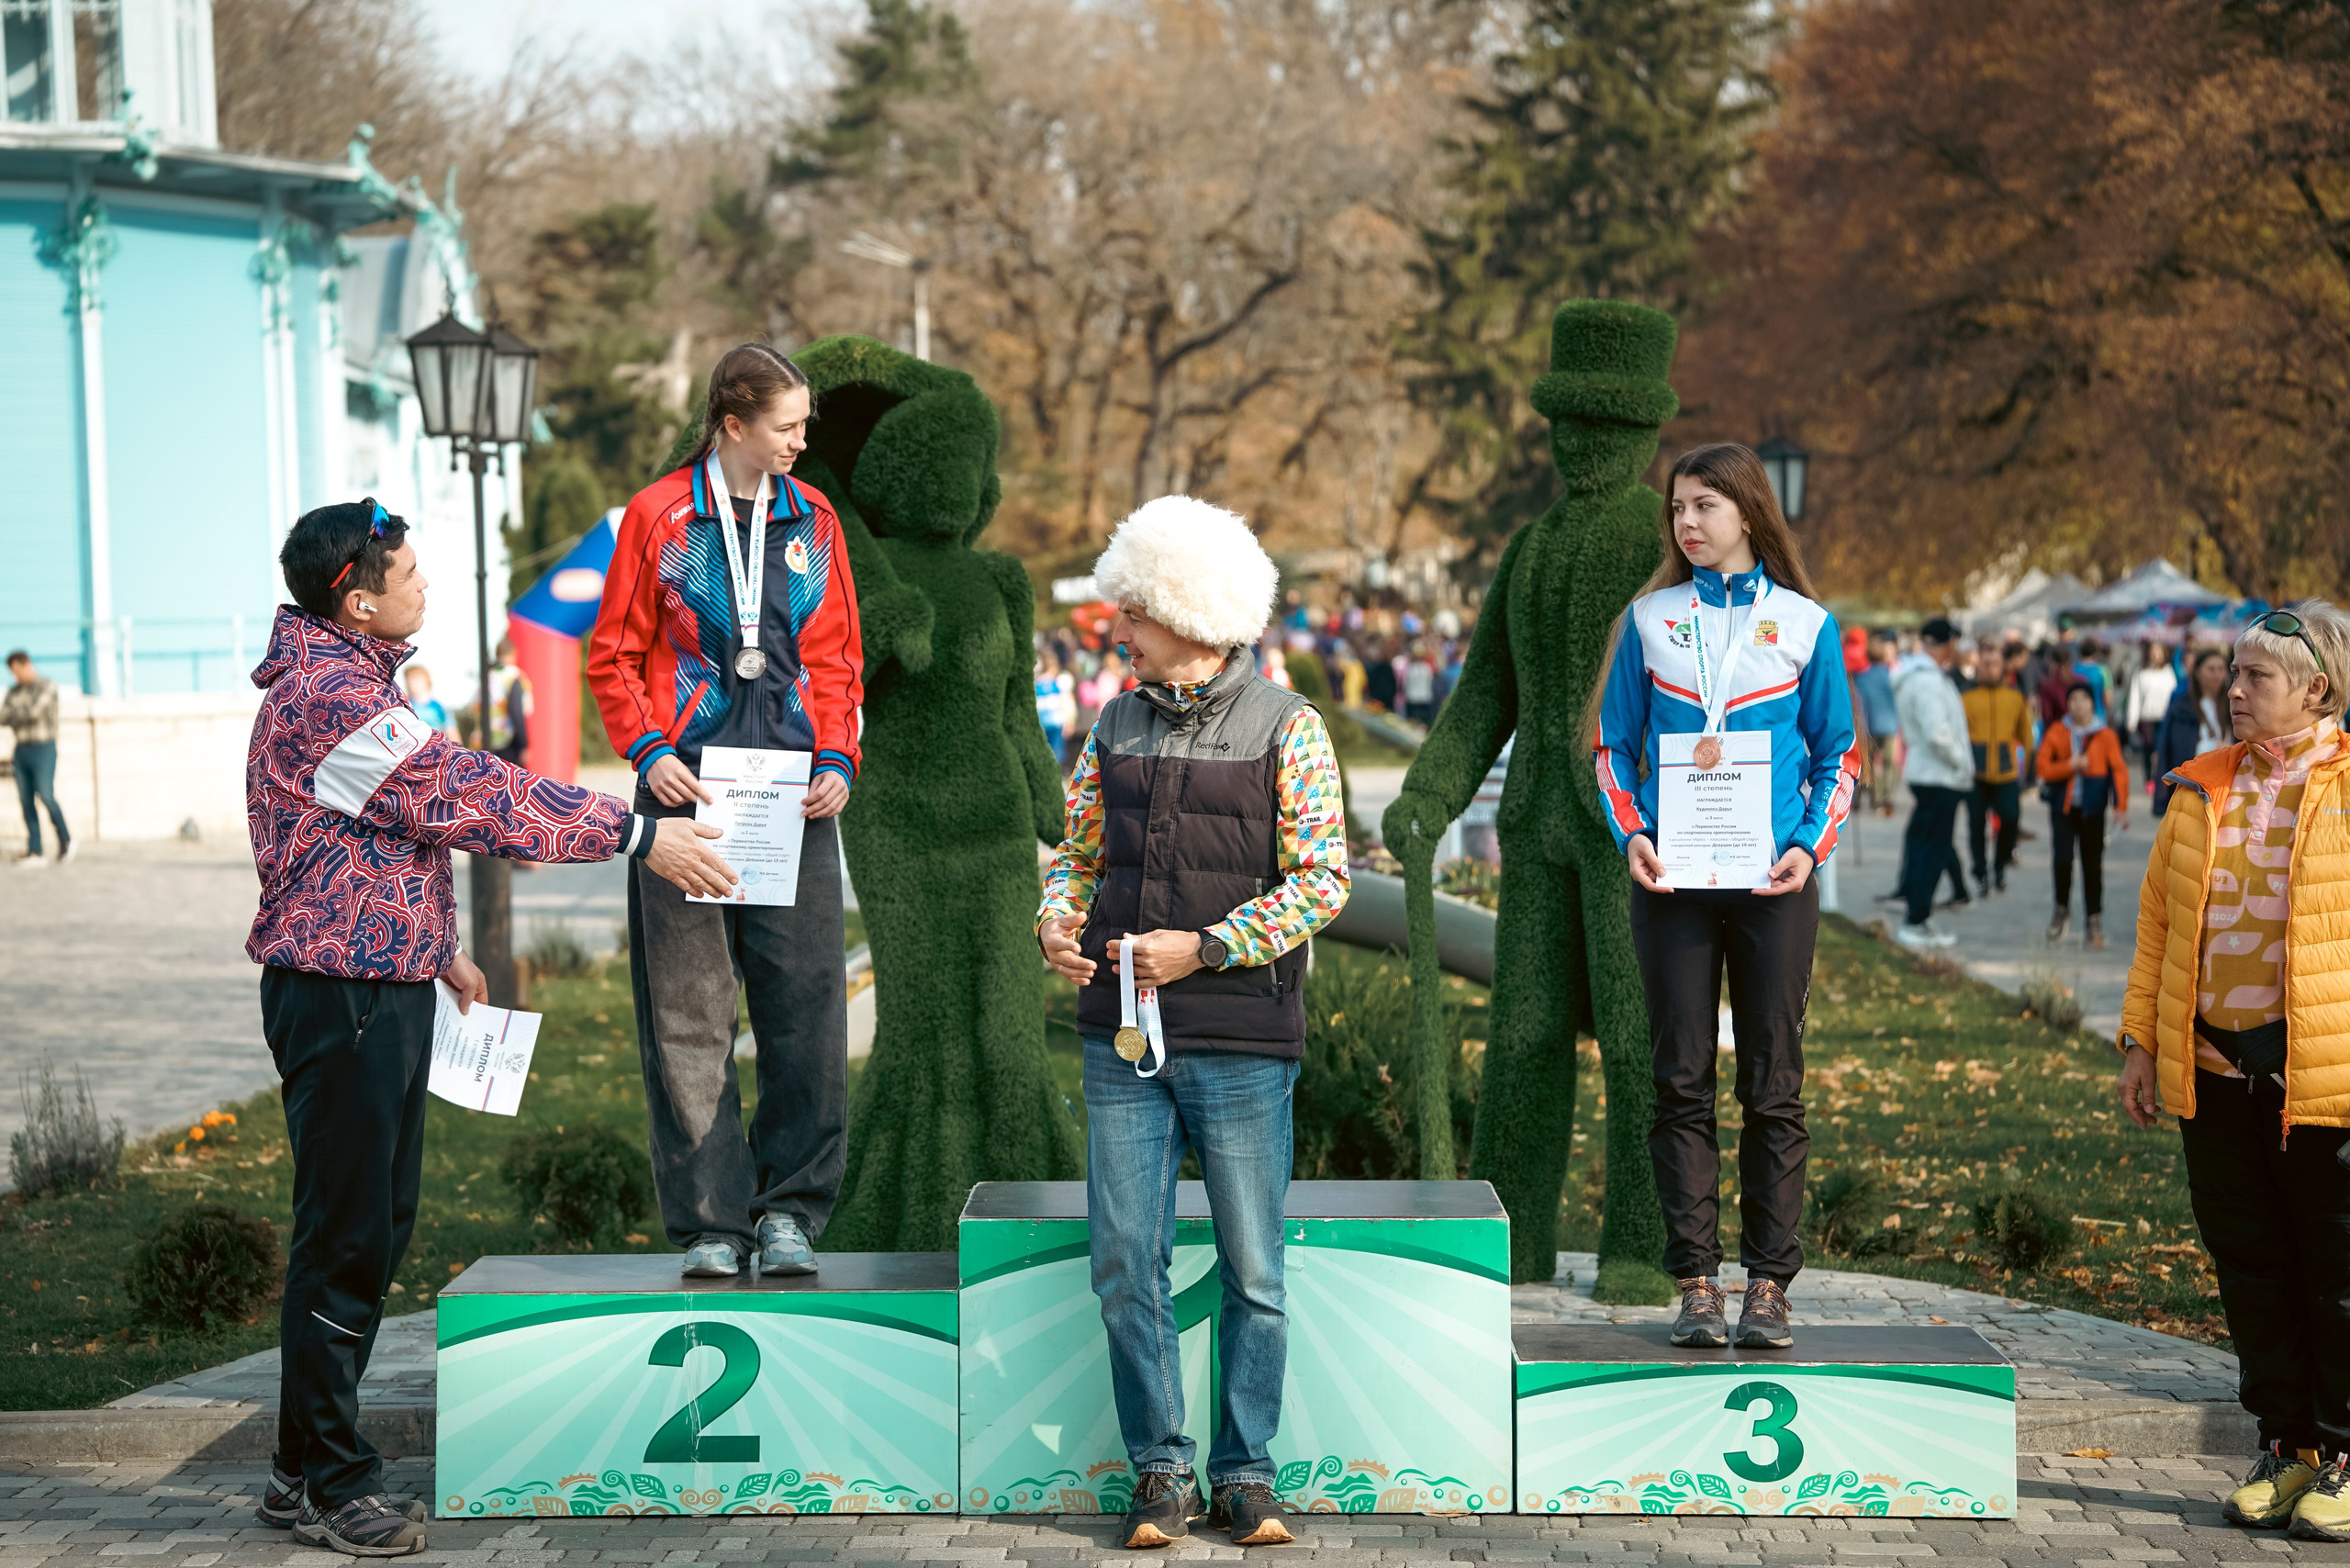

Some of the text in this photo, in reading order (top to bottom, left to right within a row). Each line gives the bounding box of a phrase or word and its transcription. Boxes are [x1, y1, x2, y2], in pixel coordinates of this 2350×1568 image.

[726, 789, 779, 800] ДИПЛОМ
[1687, 772, 1741, 783] ДИПЛОМ
[467, 1043, 477, 1069] степень
[474, 1033, 494, 1082] ДИПЛОМ
[643, 1321, 761, 1463] 2
[1723, 1381, 1804, 1482] 3
